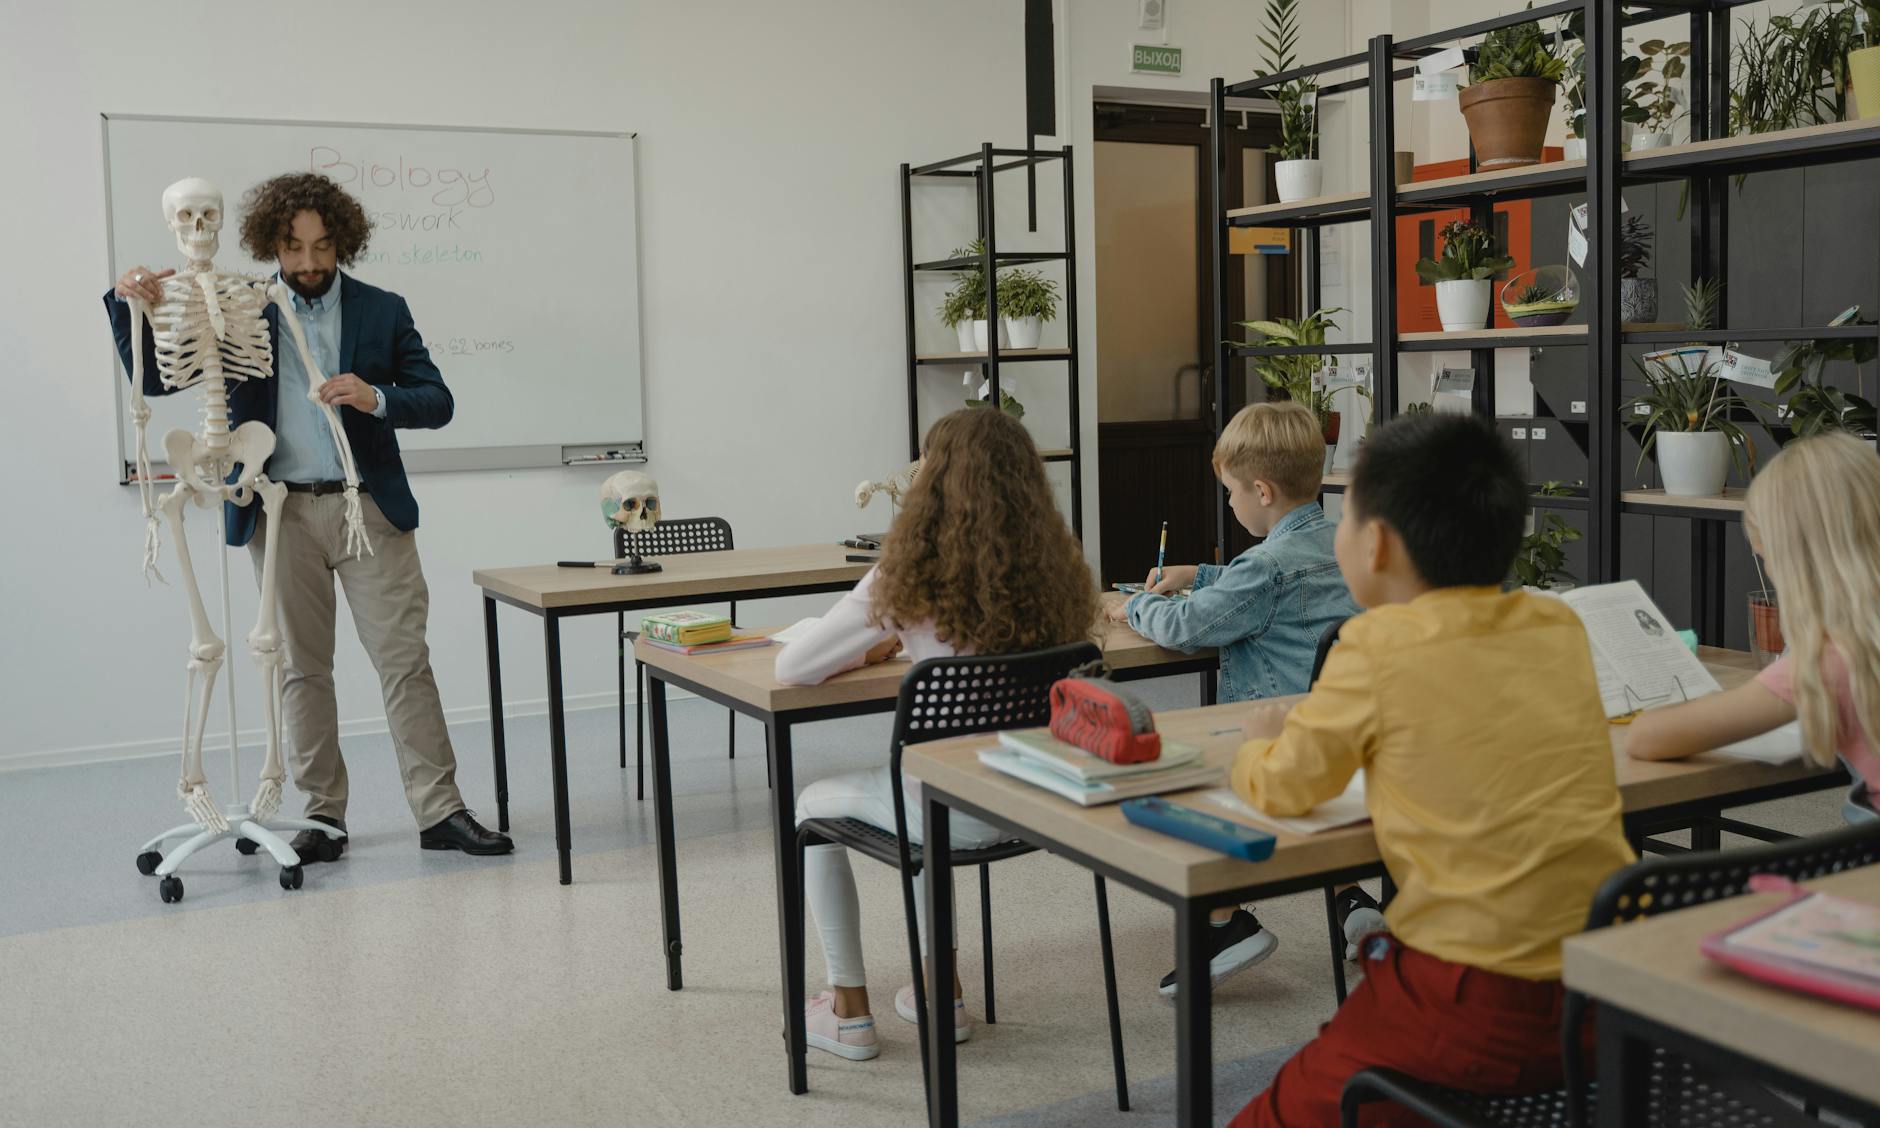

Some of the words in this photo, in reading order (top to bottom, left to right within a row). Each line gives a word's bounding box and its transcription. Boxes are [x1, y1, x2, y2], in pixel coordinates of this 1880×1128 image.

[1135, 50, 1180, 70] ВЫХОД
[310, 146, 495, 207] Biology
[398, 244, 482, 264] skeleton
[473, 338, 515, 354] bones
